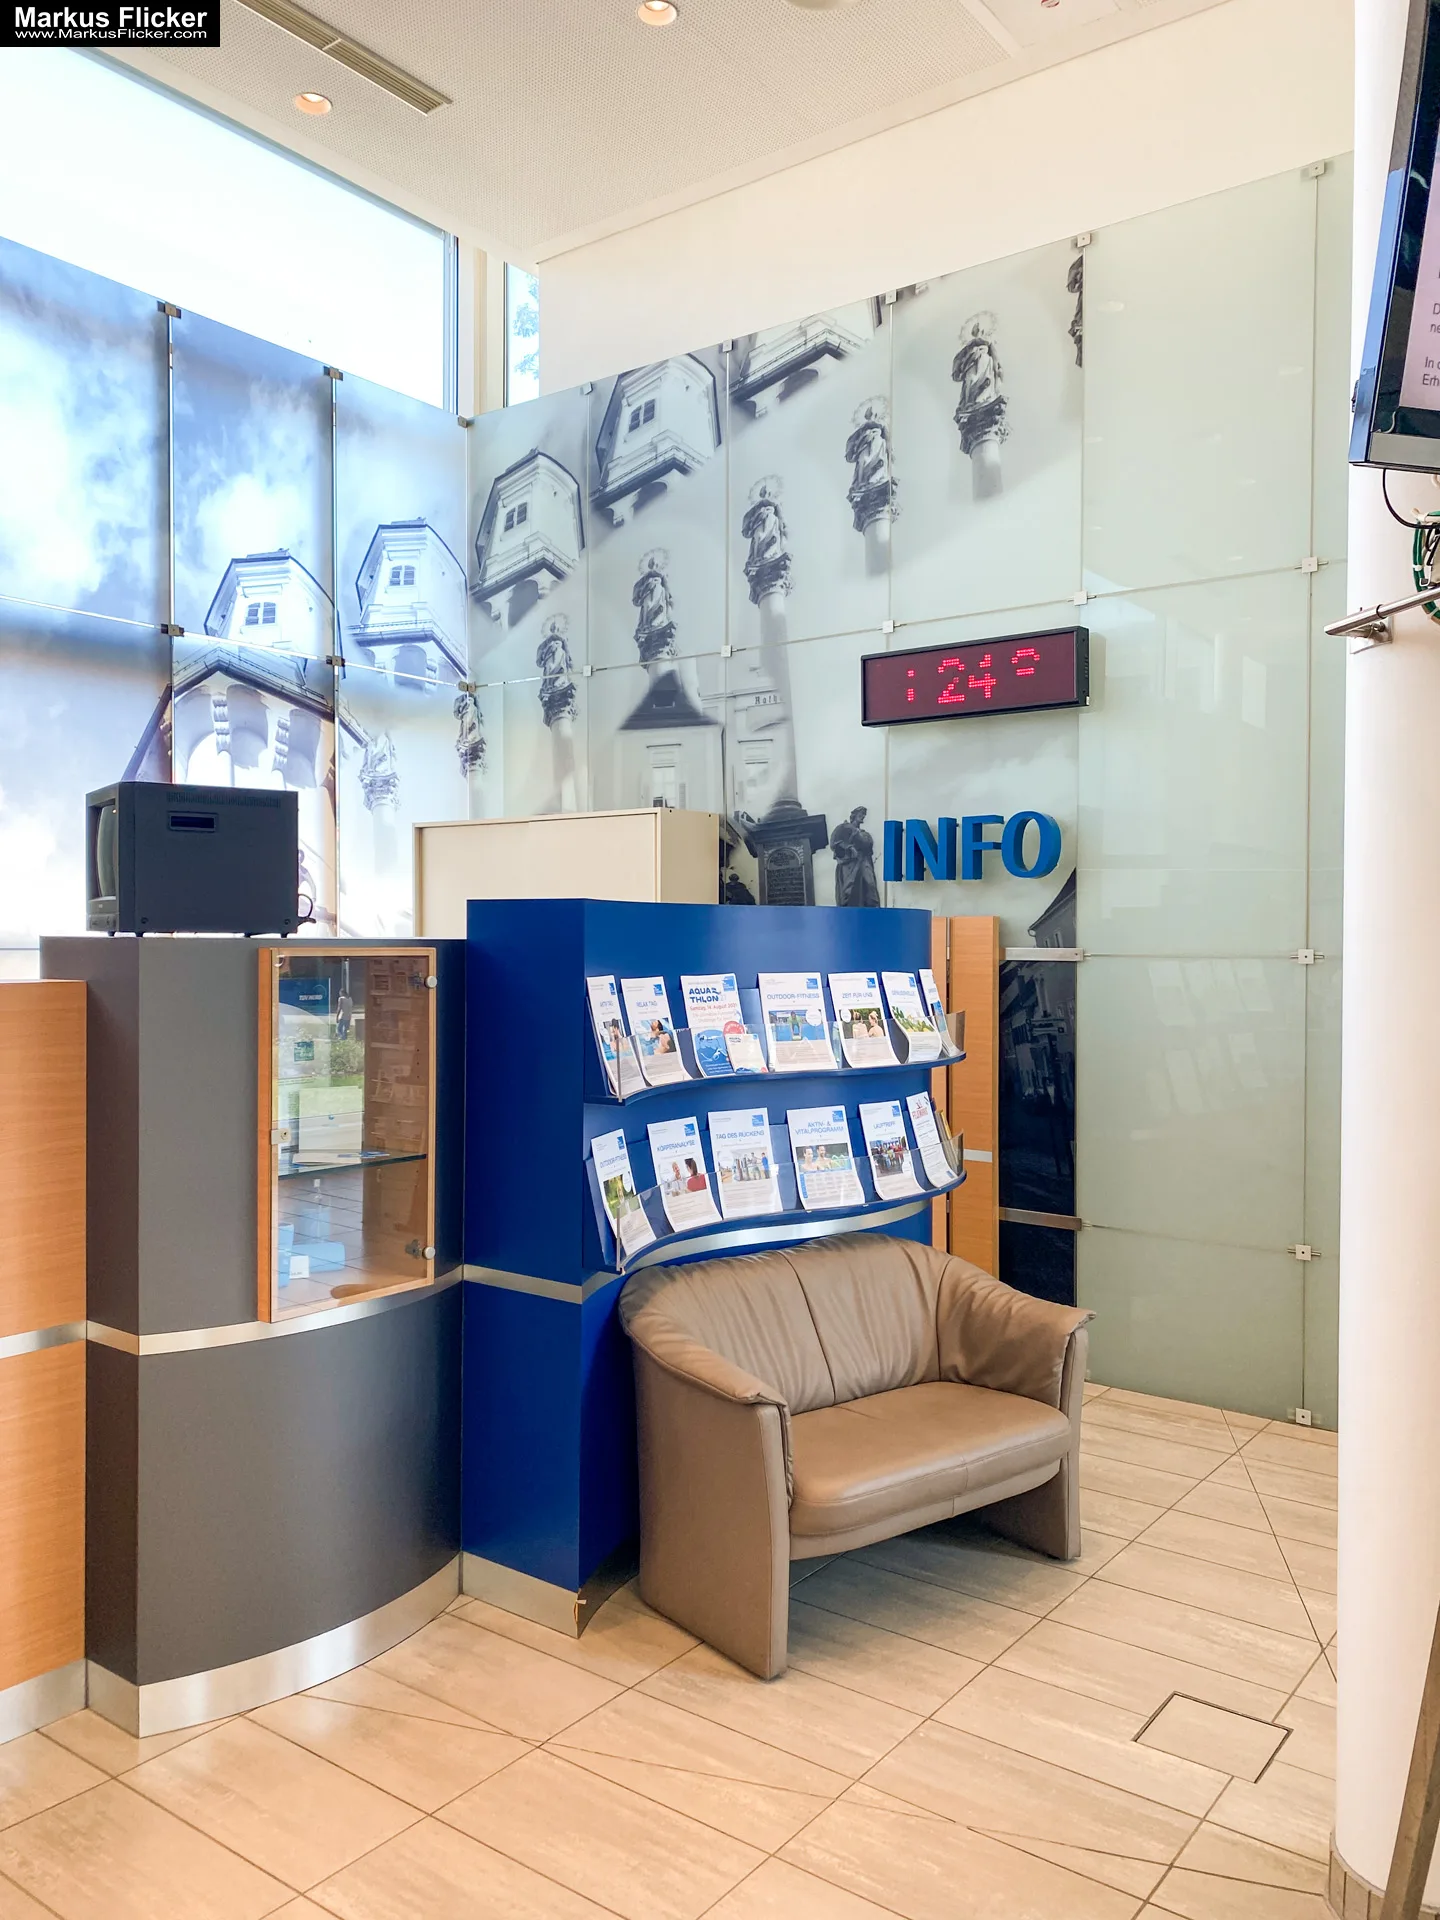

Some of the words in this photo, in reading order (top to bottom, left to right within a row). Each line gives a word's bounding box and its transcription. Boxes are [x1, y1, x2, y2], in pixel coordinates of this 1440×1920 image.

[1424, 356, 1434, 369] In
[883, 810, 1062, 882] INFO
[689, 995, 719, 1003] THLON
[716, 1132, 727, 1140] TAG
